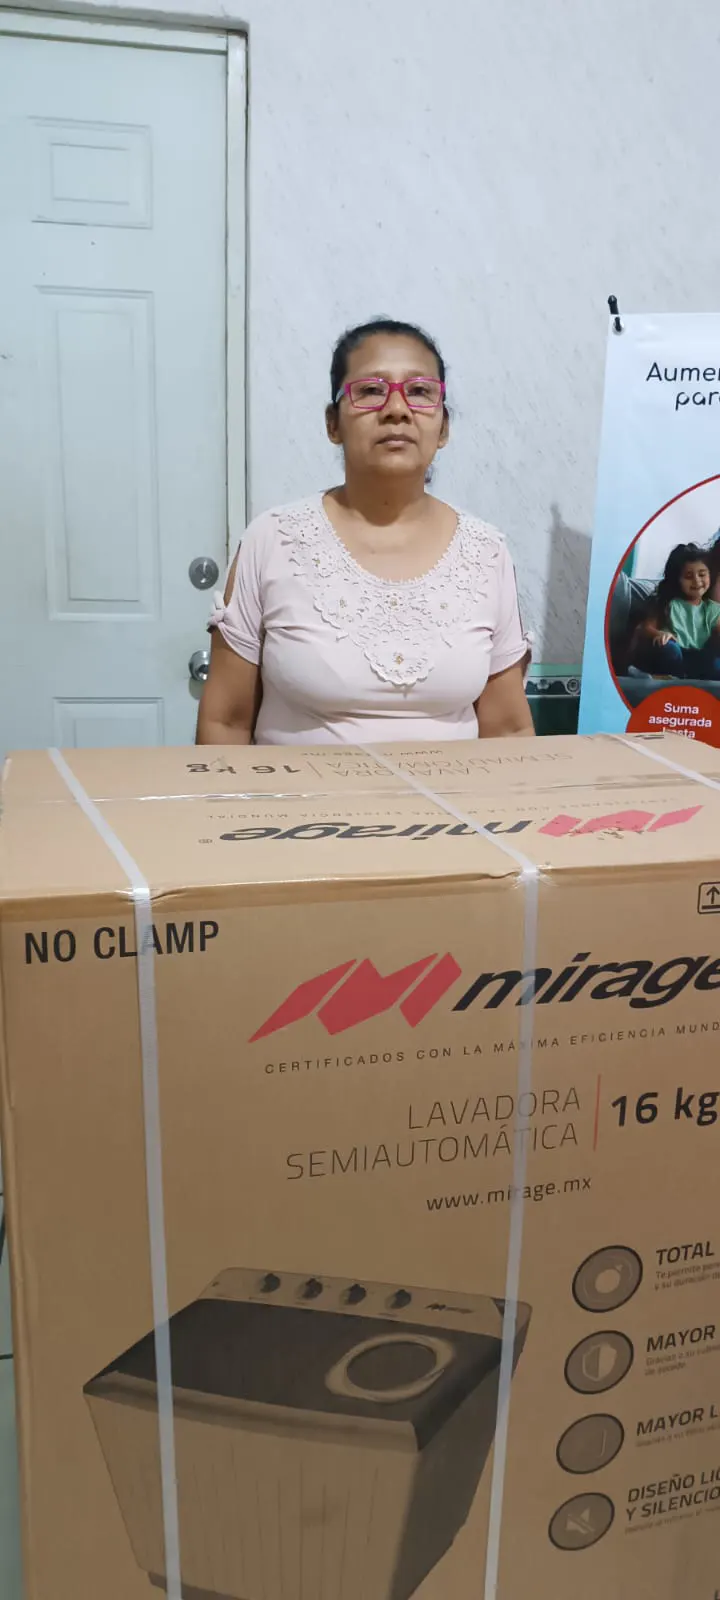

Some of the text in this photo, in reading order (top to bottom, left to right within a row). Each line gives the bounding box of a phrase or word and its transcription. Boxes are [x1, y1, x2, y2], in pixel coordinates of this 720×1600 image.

[646, 361, 720, 382] Aume
[675, 391, 720, 411] par
[648, 715, 712, 728] asegurada
[664, 702, 699, 714] Suma
[252, 764, 302, 774] 16
[219, 820, 533, 841] mirage
[25, 920, 219, 964] NO CLAMP
[265, 1052, 405, 1074] CERTIFICADOS
[416, 1047, 451, 1060] CON
[463, 1044, 482, 1056] LA
[570, 1027, 666, 1046] EFICIENCIA
[407, 1086, 581, 1131] LAVADORA
[611, 1086, 720, 1127] 16 kg
[285, 1122, 579, 1180] SEMIAUTOMÁTICA
[656, 1240, 716, 1266] TOTAL
[647, 1325, 716, 1353] MAYOR
[636, 1407, 704, 1437] MAYOR
[627, 1472, 695, 1503] DISEÑO
[626, 1506, 637, 1522] Y
